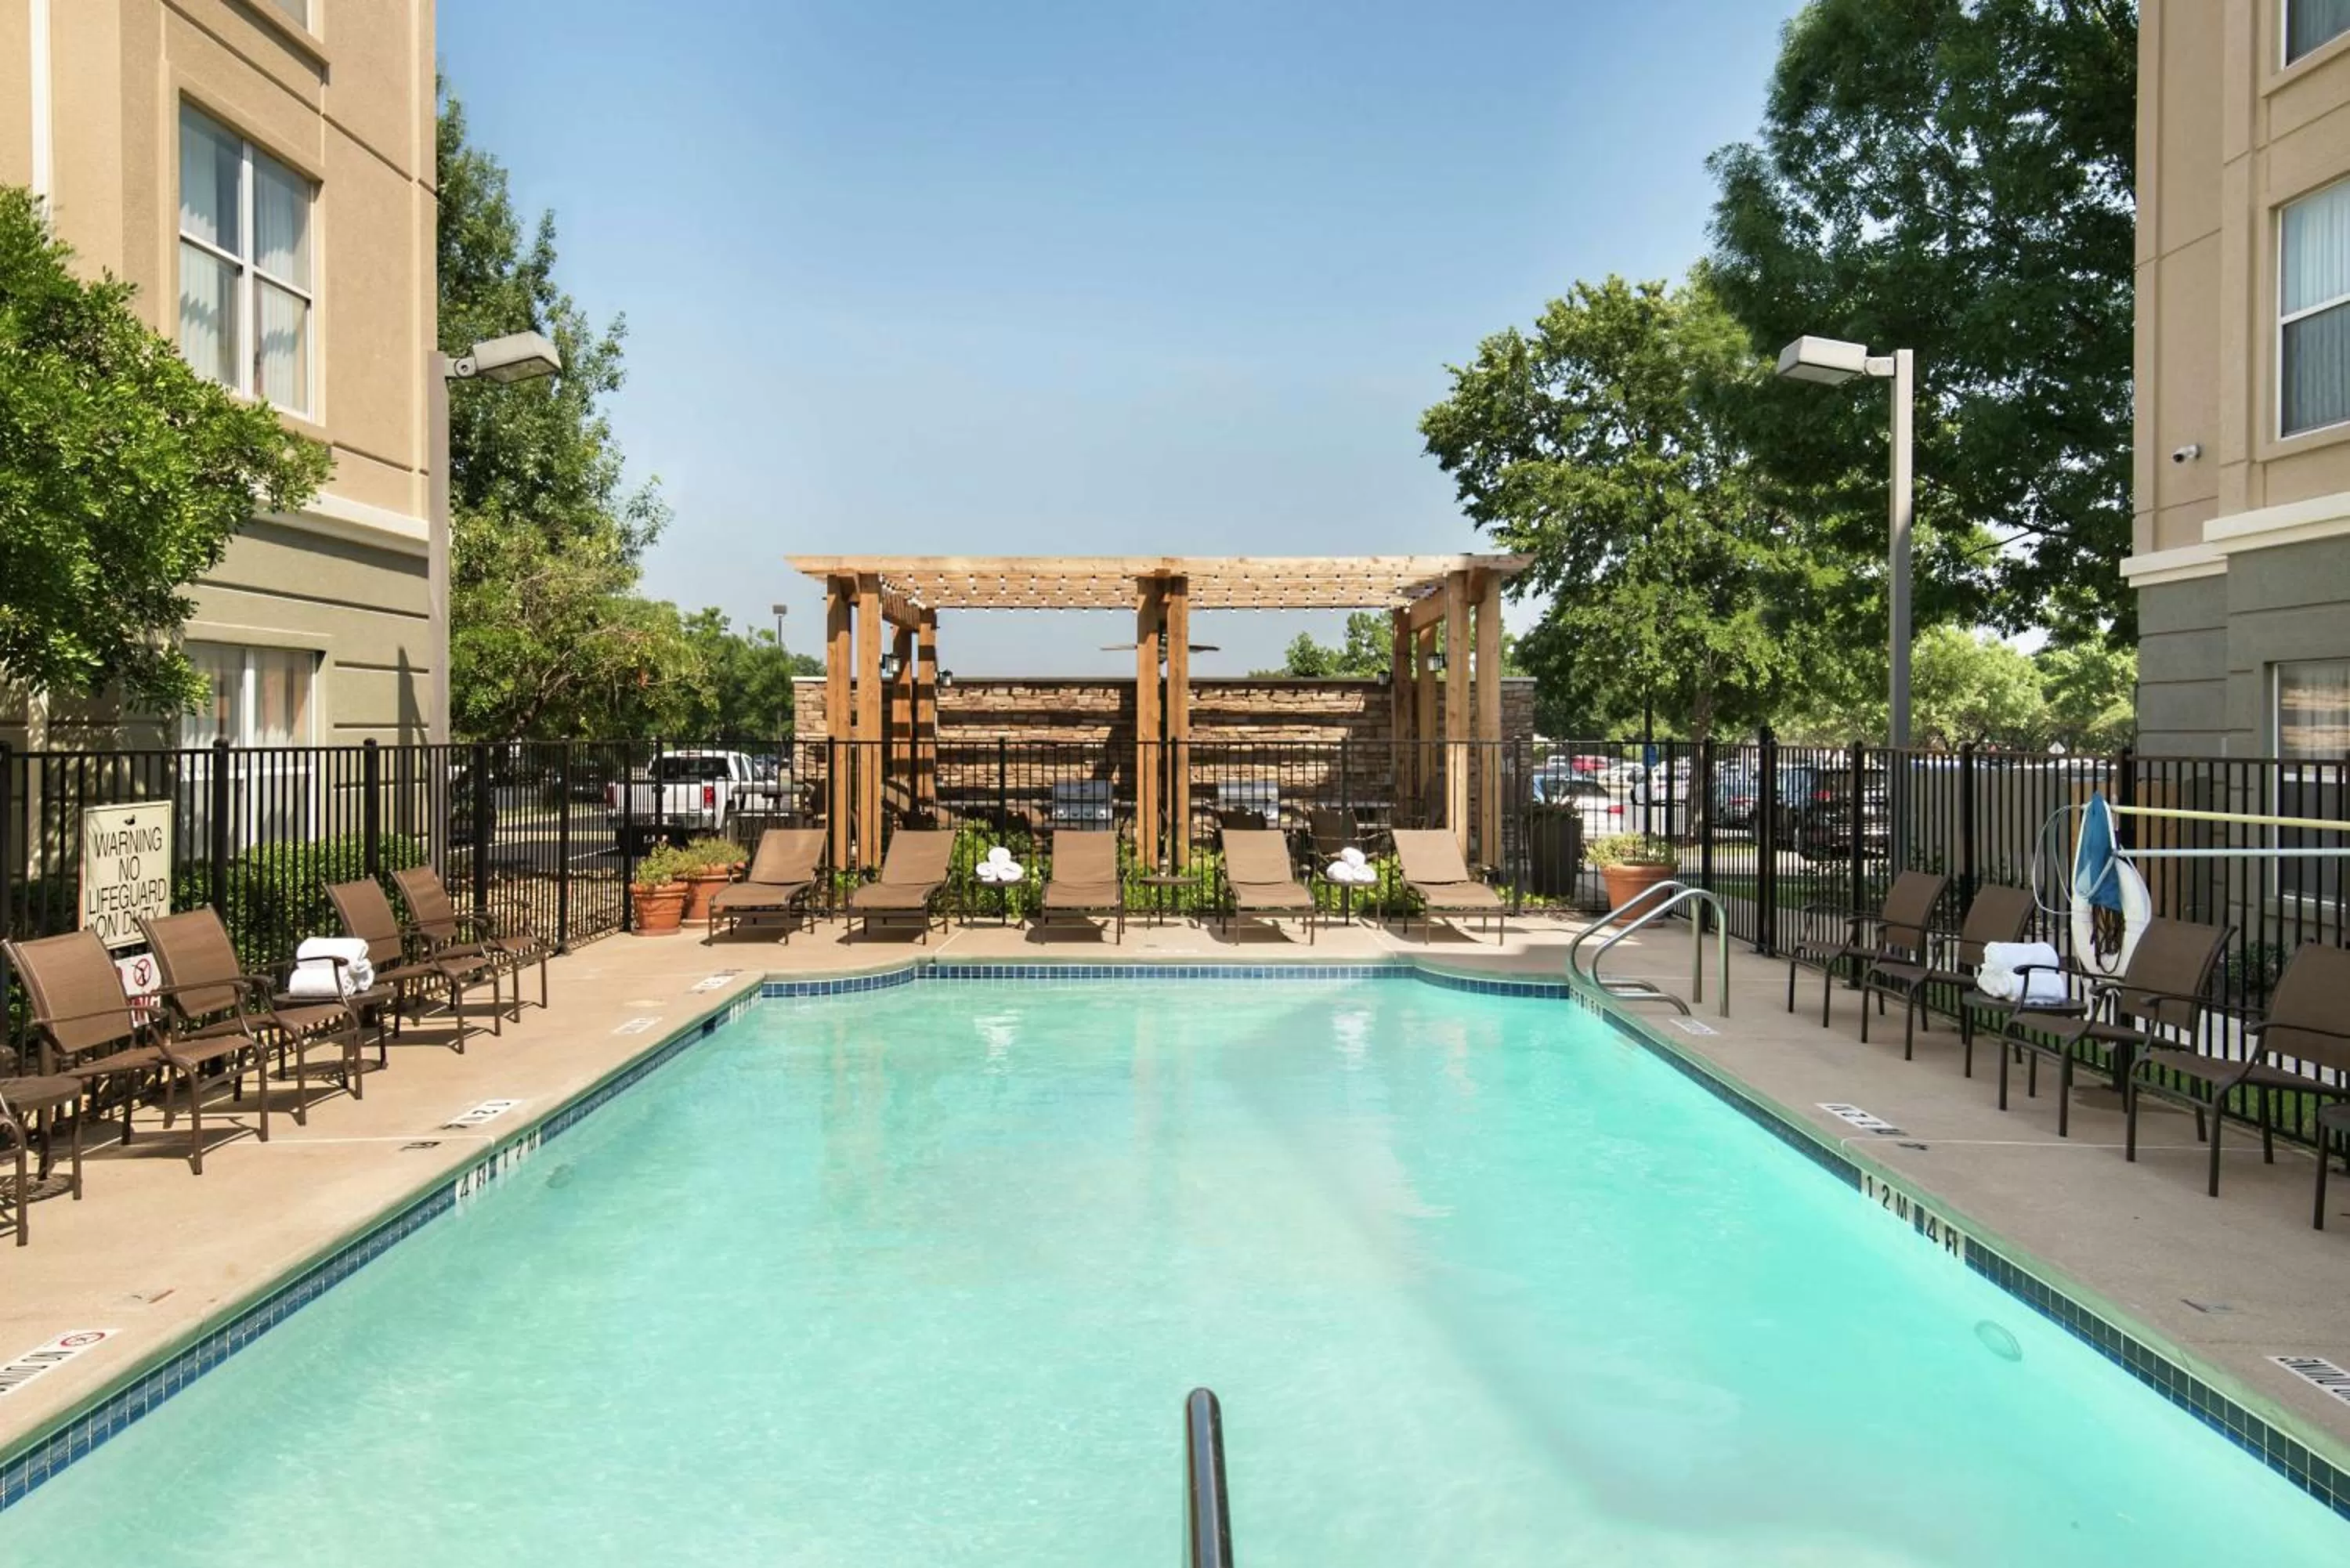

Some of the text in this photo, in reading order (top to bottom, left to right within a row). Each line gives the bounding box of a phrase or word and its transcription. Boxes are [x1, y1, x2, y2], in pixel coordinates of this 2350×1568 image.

[95, 827, 162, 858] WARNING
[118, 856, 140, 882] NO
[89, 878, 167, 915] LIFEGUARD
[96, 913, 118, 939] ON
